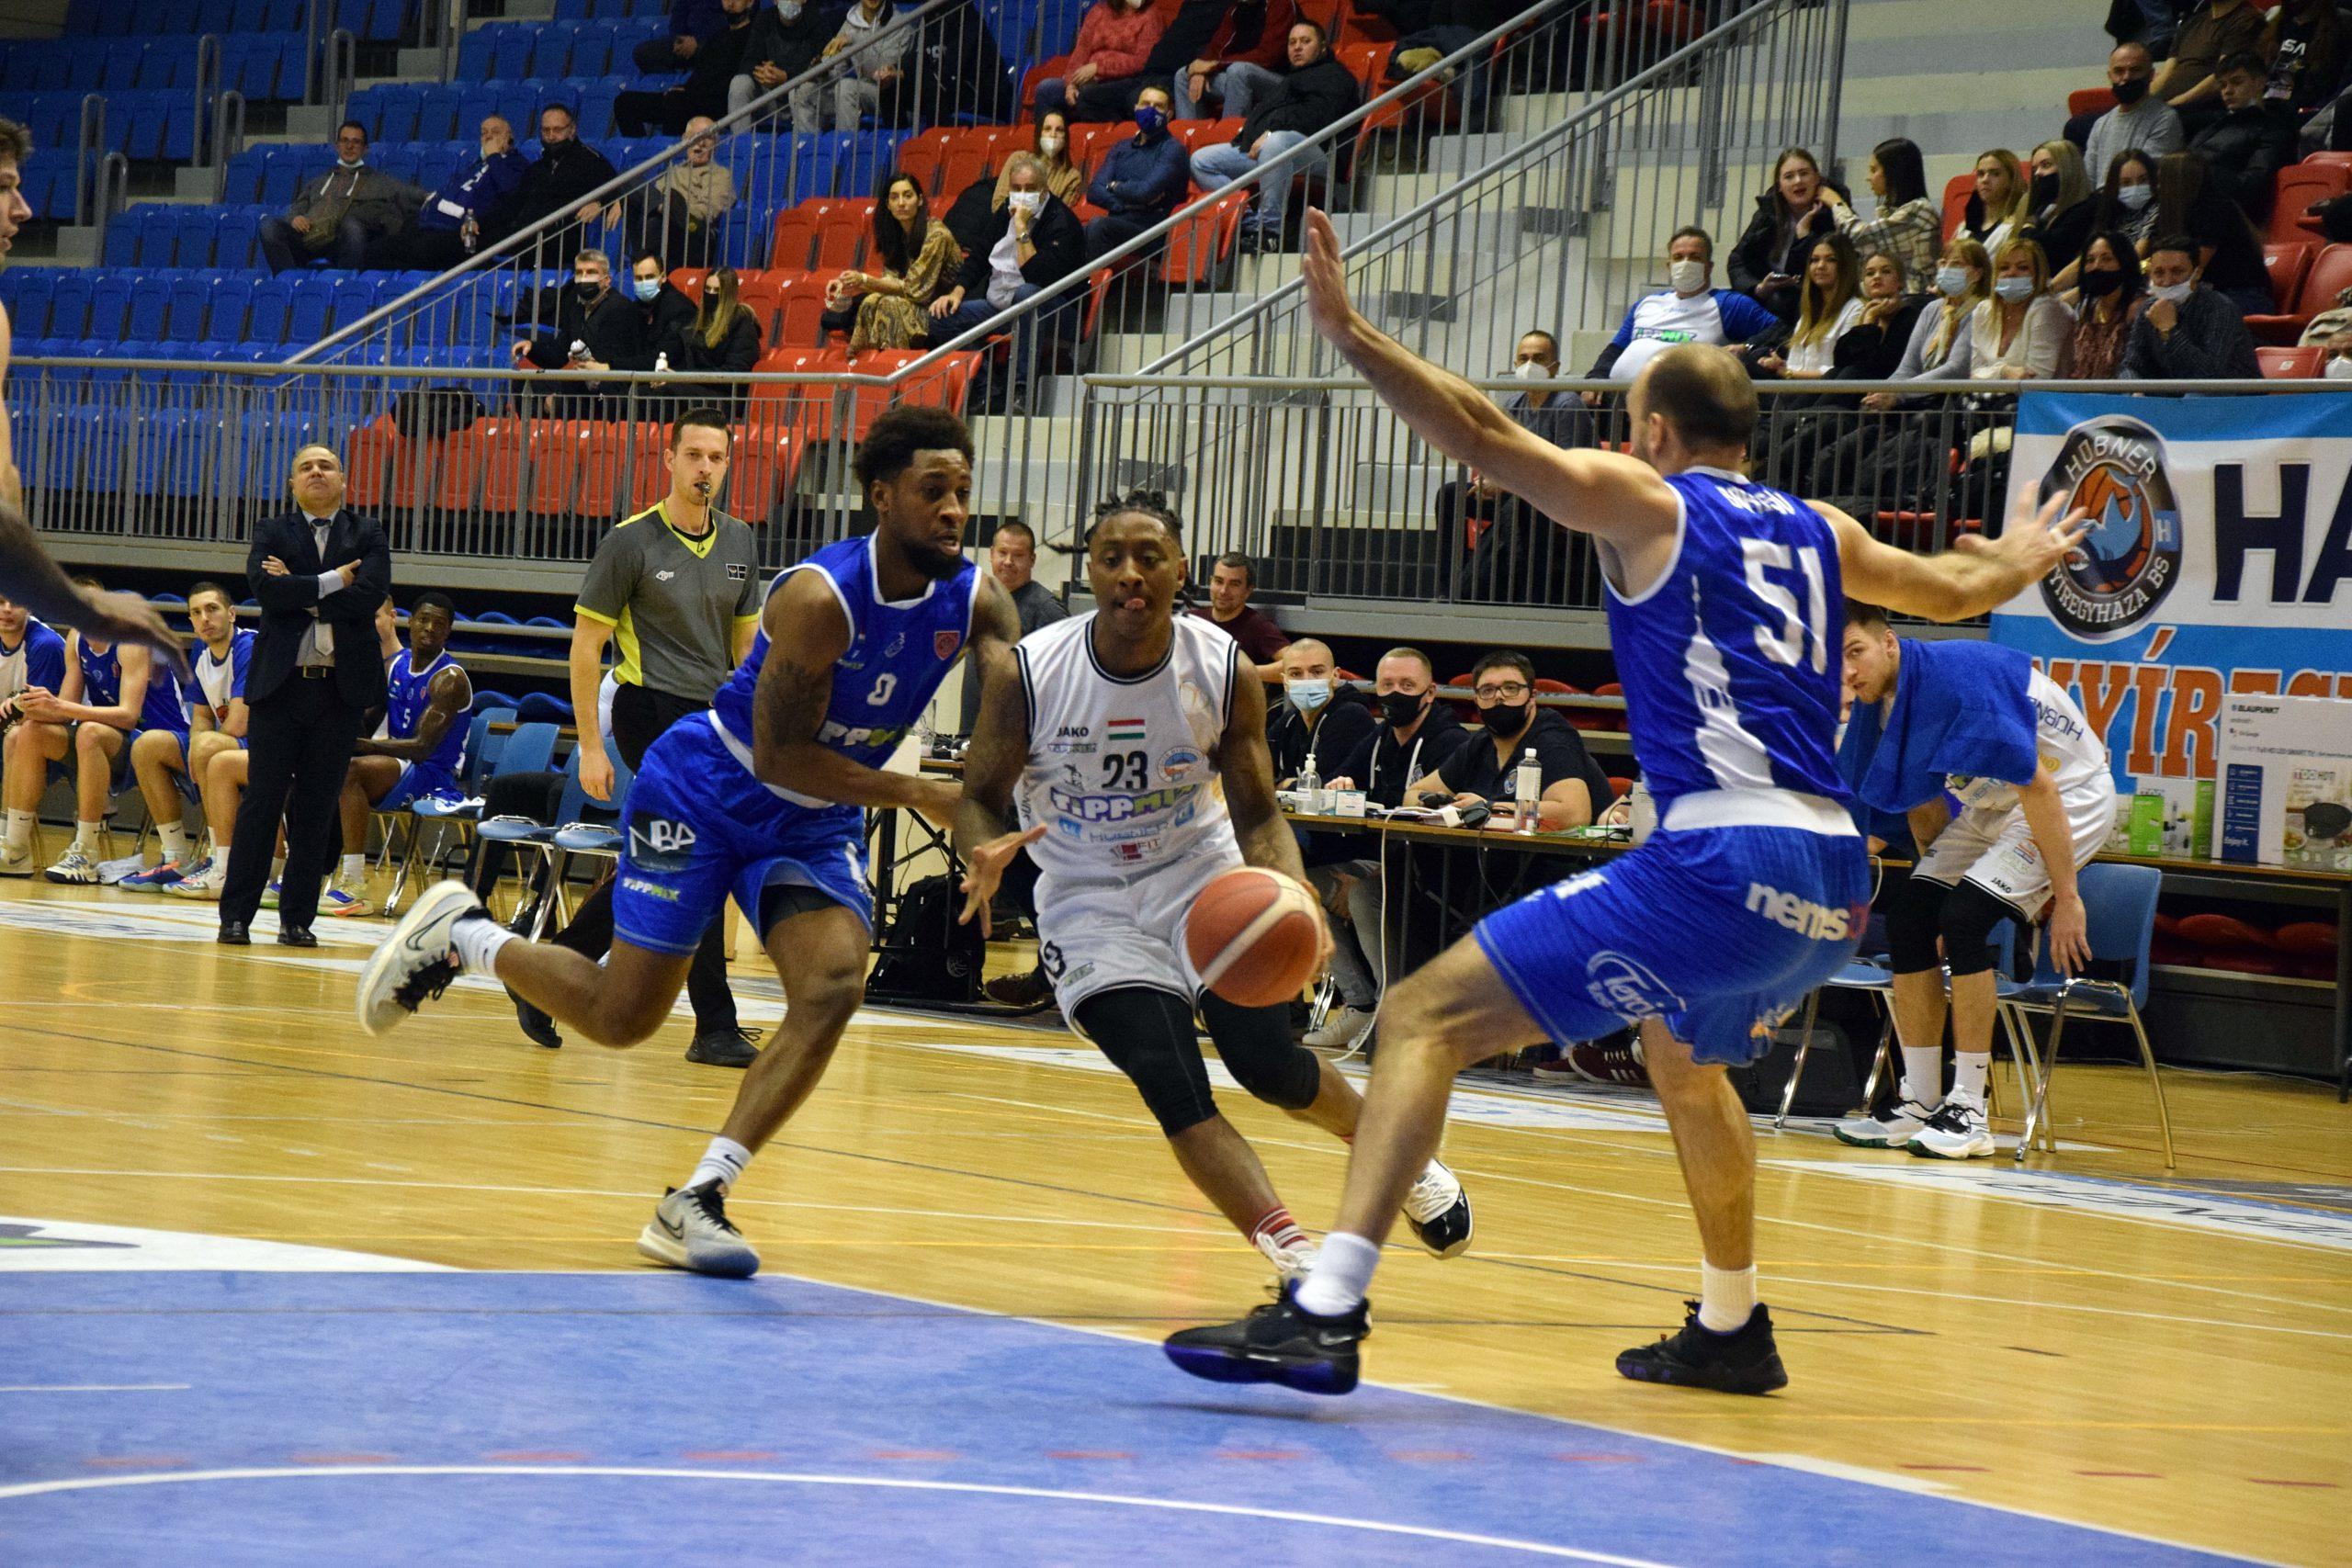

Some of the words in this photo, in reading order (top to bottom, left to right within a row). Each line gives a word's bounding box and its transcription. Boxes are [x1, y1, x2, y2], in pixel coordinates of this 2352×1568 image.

[1740, 537, 1828, 676] 51
[2047, 562, 2151, 624] YÍREGYHÁZA
[2146, 555, 2170, 590] BS
[866, 672, 899, 706] 0
[1057, 726, 1090, 738] JAKO
[1102, 750, 1148, 791] 23
[1990, 876, 2012, 894] JAKO
